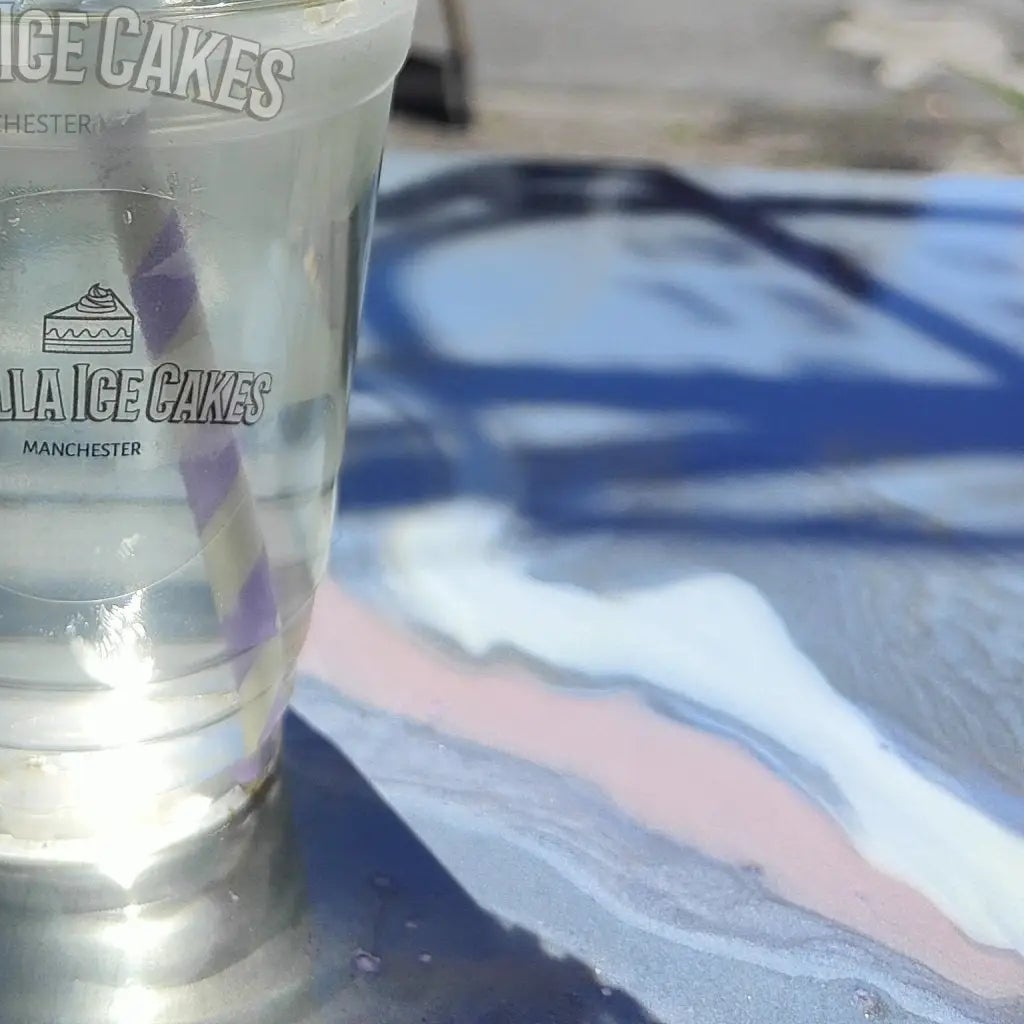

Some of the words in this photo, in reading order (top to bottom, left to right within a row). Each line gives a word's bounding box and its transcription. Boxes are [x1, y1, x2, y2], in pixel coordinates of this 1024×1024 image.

[71, 362, 144, 423] ICE
[146, 362, 274, 425] CAKES
[22, 439, 142, 458] MANCHESTER
